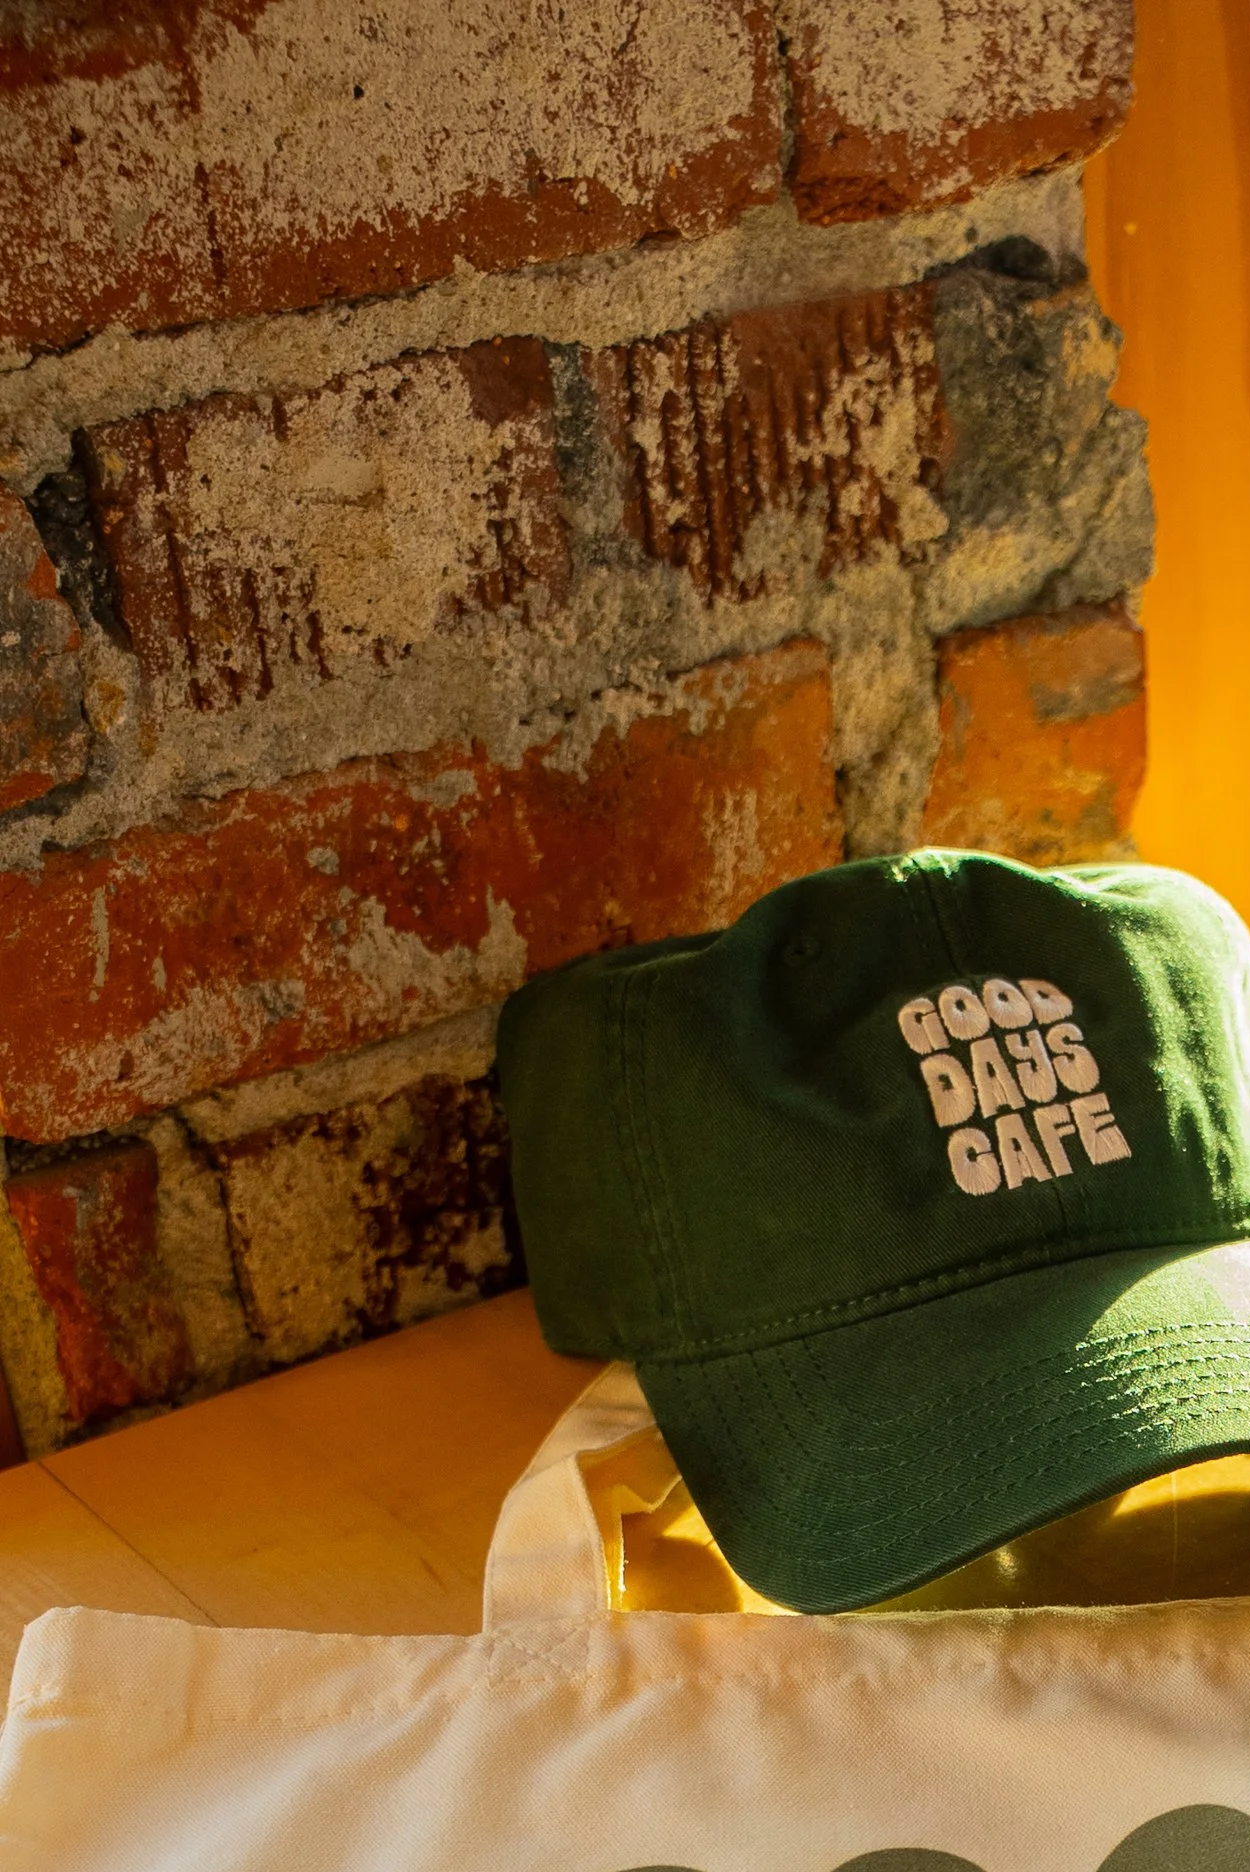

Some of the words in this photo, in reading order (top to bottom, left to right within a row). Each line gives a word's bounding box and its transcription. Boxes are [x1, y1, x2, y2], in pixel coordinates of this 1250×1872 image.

[898, 978, 1074, 1055] GOOD
[919, 1022, 1101, 1129] DAYS
[947, 1092, 1132, 1196] CAFE
